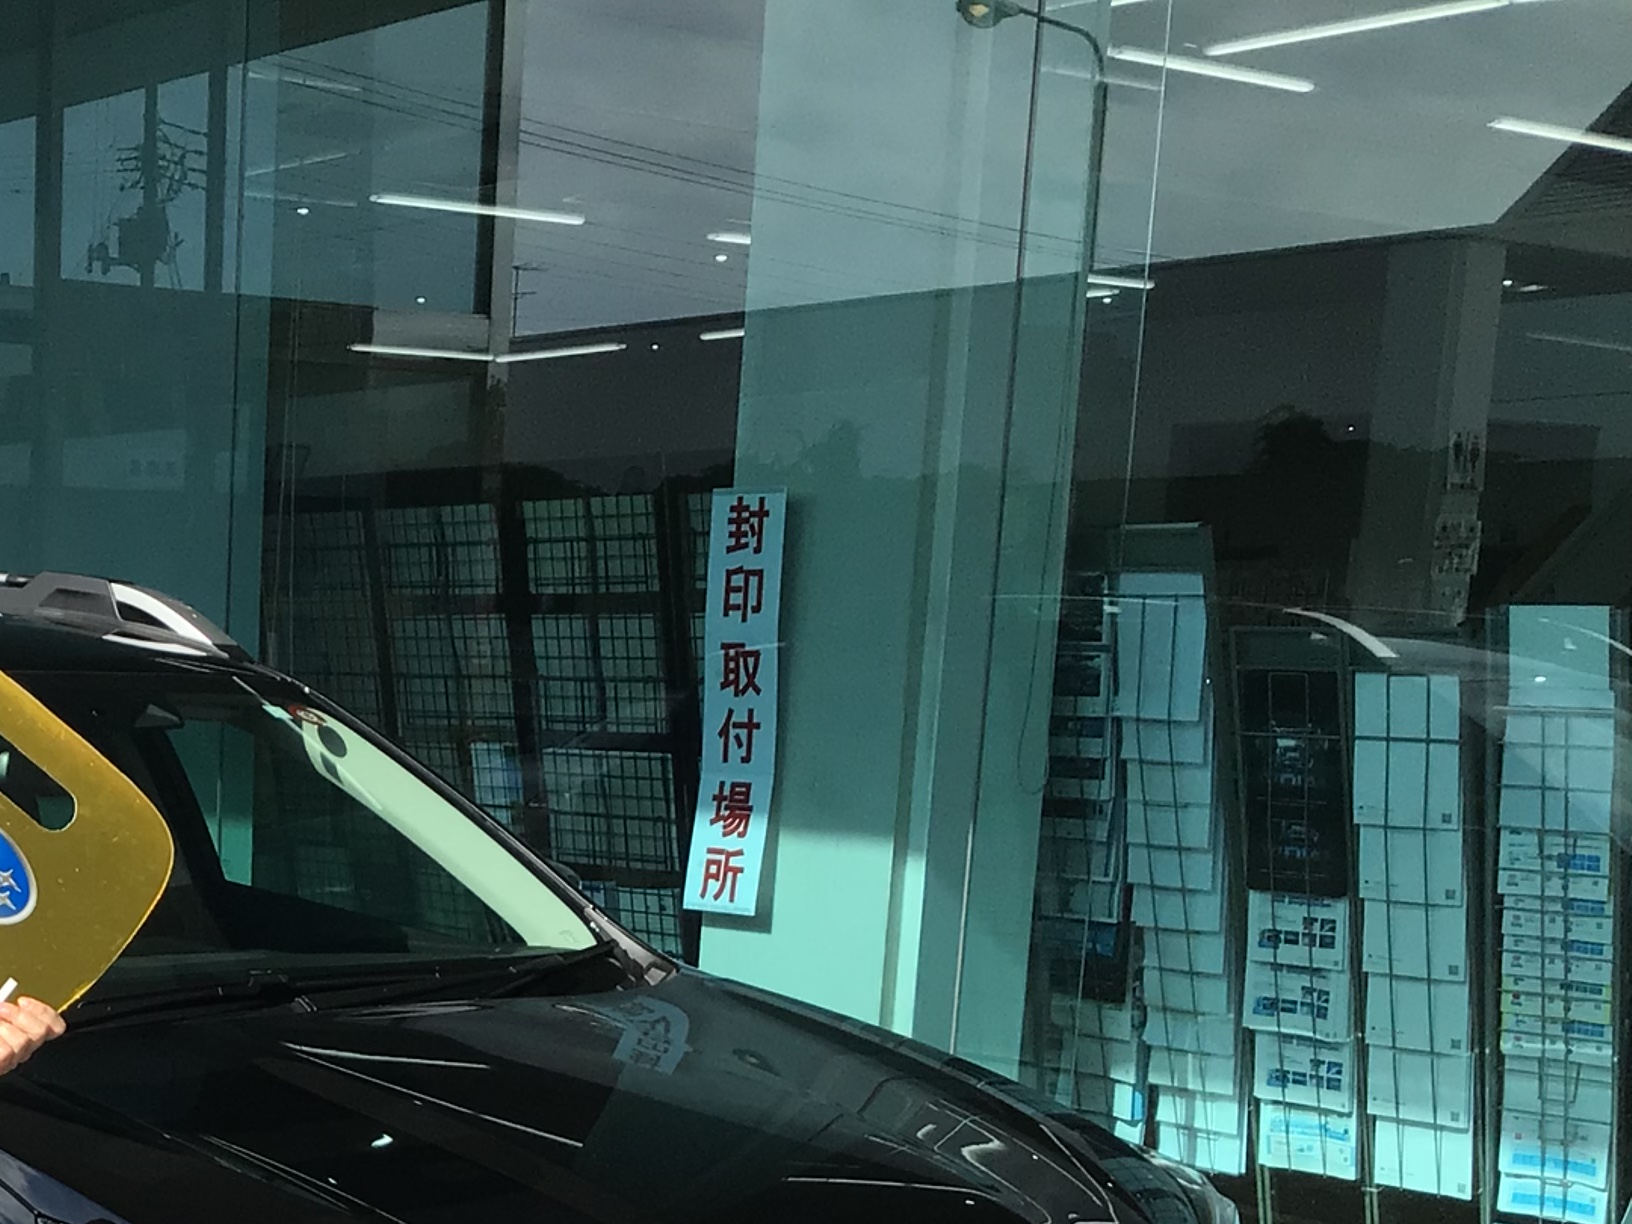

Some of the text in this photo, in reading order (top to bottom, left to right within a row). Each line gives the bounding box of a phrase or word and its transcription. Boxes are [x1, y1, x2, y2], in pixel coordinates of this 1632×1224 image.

[699, 495, 770, 903] 封印取付場所
